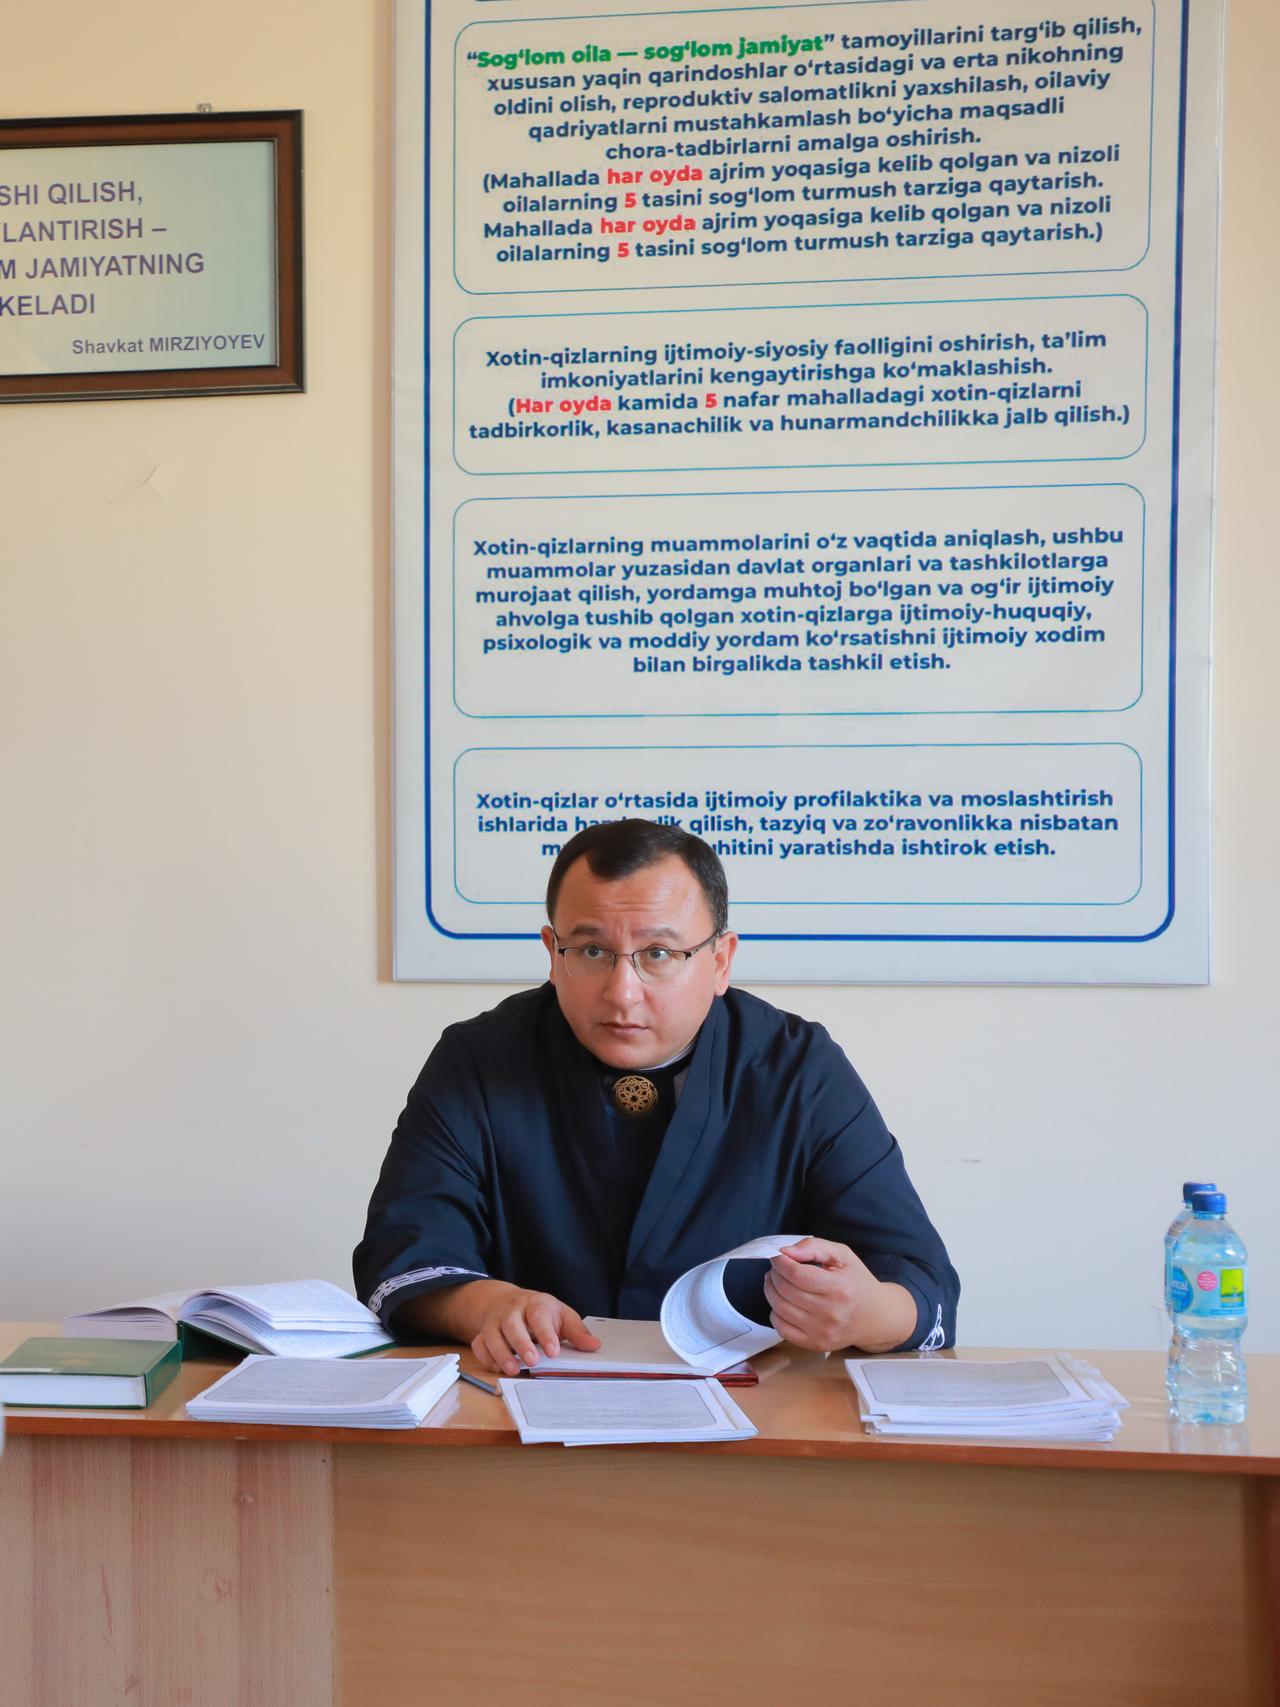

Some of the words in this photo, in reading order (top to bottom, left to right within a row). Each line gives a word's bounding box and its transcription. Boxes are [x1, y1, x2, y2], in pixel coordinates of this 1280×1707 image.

[572, 43, 612, 66] oila
[841, 26, 984, 51] tamoyillarini
[1073, 17, 1141, 37] qilish,
[488, 75, 575, 96] xususan
[582, 67, 641, 91] yaqin
[648, 61, 788, 88] qarindoshlar
[920, 57, 945, 71] va
[953, 52, 998, 69] erta
[1006, 45, 1123, 67] nikohning
[494, 95, 553, 116] oldini
[560, 94, 616, 114] olish,
[623, 86, 753, 114] reproduktiv
[759, 79, 896, 104] salomatlikni
[903, 74, 1028, 101] yaxshilash,
[1035, 69, 1111, 90] oilaviy
[528, 115, 667, 143] qadriyatlarni
[674, 108, 851, 134] mustahkamlash
[960, 97, 1064, 121] maqsadli
[605, 134, 790, 161] chora-tadbirlarni
[798, 132, 879, 154] amalga
[886, 127, 981, 148] oshirish.
[483, 168, 599, 193] (Mahallada
[607, 167, 643, 185] har
[649, 164, 703, 187] oyda
[709, 161, 765, 185] ajrim
[771, 157, 870, 183] yoqasiga
[878, 153, 933, 173] kelib
[939, 152, 1018, 175] qolgan
[1024, 152, 1051, 166] va
[1058, 145, 1119, 165] nizoli
[47, 180, 143, 207] QILISH,
[503, 191, 617, 214] oilalarning
[624, 191, 636, 209] 5
[641, 188, 702, 209] tasini
[801, 180, 896, 201] turmush
[903, 177, 981, 198] tarziga
[988, 171, 1103, 197] qaytarish.
[484, 218, 592, 240] Mahallada
[601, 217, 636, 234] har
[641, 214, 696, 237] oyda
[702, 211, 757, 235] ajrim
[764, 206, 863, 232] yoqasiga
[870, 203, 925, 224] kelib
[931, 201, 1009, 225] qolgan
[1017, 202, 1042, 217] va
[1050, 196, 1111, 216] nizoli
[496, 241, 610, 263] oilalarning
[617, 242, 630, 259] 5
[635, 237, 694, 258] tasini
[794, 231, 889, 252] turmush
[895, 228, 974, 249] tarziga
[981, 222, 1102, 248] qaytarish.)
[25, 252, 205, 281] JAMIYATNING
[72, 338, 144, 355] Shavkat
[150, 334, 265, 353] MIRZIYOYEV
[486, 345, 657, 369] Xotin-qizlarning
[664, 338, 829, 366] ijtimoiy-siyosiy
[834, 335, 932, 359] faolligini
[939, 332, 1035, 353] oshirish,
[541, 366, 703, 392] imkoniyatlarini
[710, 363, 875, 388] kengaytirishga
[508, 397, 554, 418] (Har
[559, 395, 612, 417] oyda
[617, 392, 698, 415] kamida
[705, 392, 717, 409] 5
[723, 390, 780, 409] nafar
[787, 384, 924, 408] mahalladagi
[931, 380, 1081, 405] xotin-qizlarni
[469, 419, 600, 439] tadbirkorlik,
[607, 415, 743, 437] kasanachilik
[749, 418, 774, 432] va
[780, 408, 999, 431] hunarmandchilikka
[1003, 407, 1048, 430] jalb
[1054, 404, 1129, 427] qilish.)
[473, 535, 643, 560] Xotin-qizlarning
[651, 531, 809, 553] muammolarini
[852, 530, 937, 553] vaqtida
[944, 528, 1046, 551] aniqlash,
[1052, 526, 1123, 545] ushbu
[486, 560, 616, 580] muammolar
[621, 558, 730, 582] yuzasidan
[736, 557, 805, 576] davlat
[811, 553, 911, 578] organlari
[917, 558, 943, 572] va
[949, 551, 1108, 574] tashkilotlarga
[476, 584, 572, 607] murojaat
[577, 583, 641, 607] qilish,
[646, 583, 756, 606] yordamga
[763, 579, 842, 602] muhtoj
[937, 582, 963, 597] va
[1028, 575, 1114, 599] ijtimoiy
[496, 610, 579, 632] ahvolga
[584, 607, 653, 627] tushib
[659, 608, 736, 629] qolgan
[740, 605, 892, 628] xotin-qizlarga
[900, 601, 1092, 626] ijtimoiy-huquqiy,
[483, 631, 592, 655] psixologik
[598, 636, 622, 651] va
[628, 630, 710, 653] moddiy
[715, 630, 799, 652] yordam
[942, 626, 1028, 650] ijtimoiy
[1034, 625, 1105, 644] xodim
[633, 655, 685, 673] bilan
[692, 653, 802, 677] birgalikda
[808, 652, 883, 672] tashkil
[889, 651, 951, 671] etish.
[476, 791, 599, 813] Xotin-qizlar
[705, 790, 787, 814] ijtimoiy
[793, 790, 922, 812] profilaktika
[928, 793, 953, 808] va
[961, 789, 1113, 808] moslashtirish
[478, 814, 568, 832] ishlarida
[689, 814, 753, 838] qilish,
[758, 814, 826, 836] tazyiq
[831, 817, 857, 831] va
[1020, 813, 1118, 832] nisbatan
[779, 837, 894, 861] yaratishda
[900, 837, 988, 857] ishtirok
[993, 837, 1056, 857] etish.
